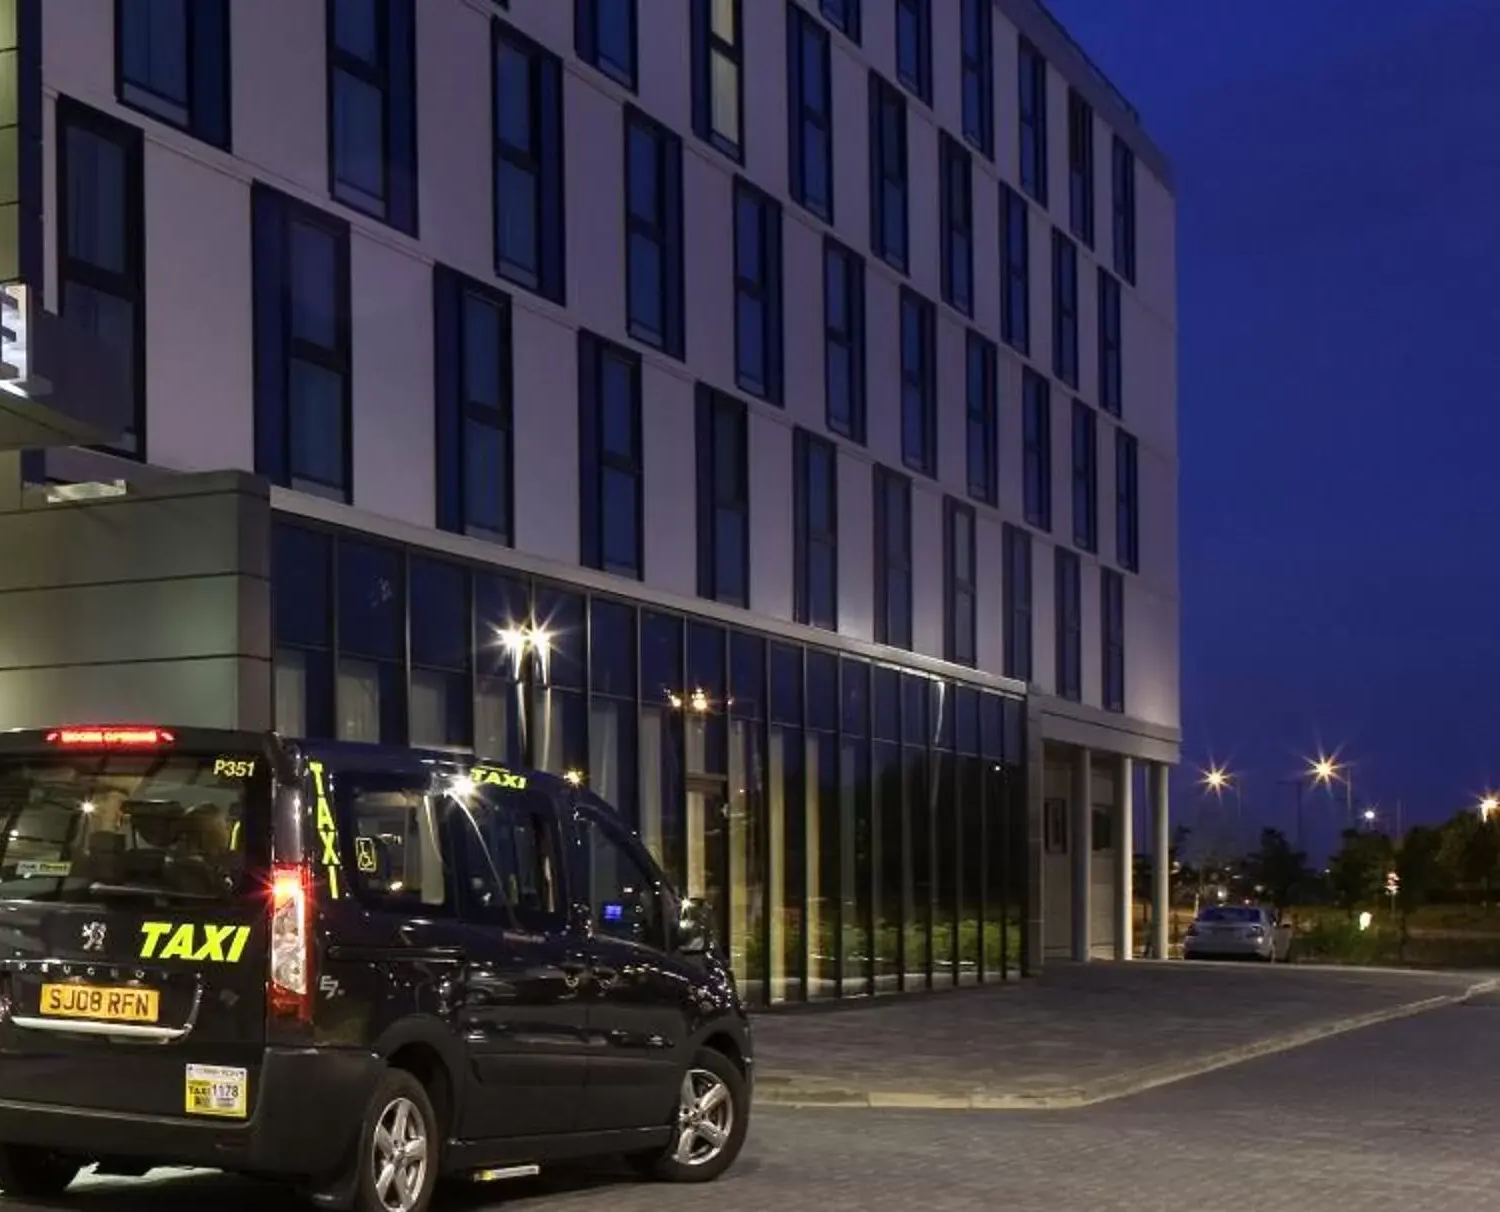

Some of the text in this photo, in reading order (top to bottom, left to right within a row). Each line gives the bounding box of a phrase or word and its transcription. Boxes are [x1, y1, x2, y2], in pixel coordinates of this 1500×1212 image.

[213, 759, 255, 778] P351
[469, 768, 527, 789] TAXI
[309, 762, 340, 899] TAXI
[140, 921, 250, 962] TAXI
[49, 989, 150, 1017] SJ08 RFN
